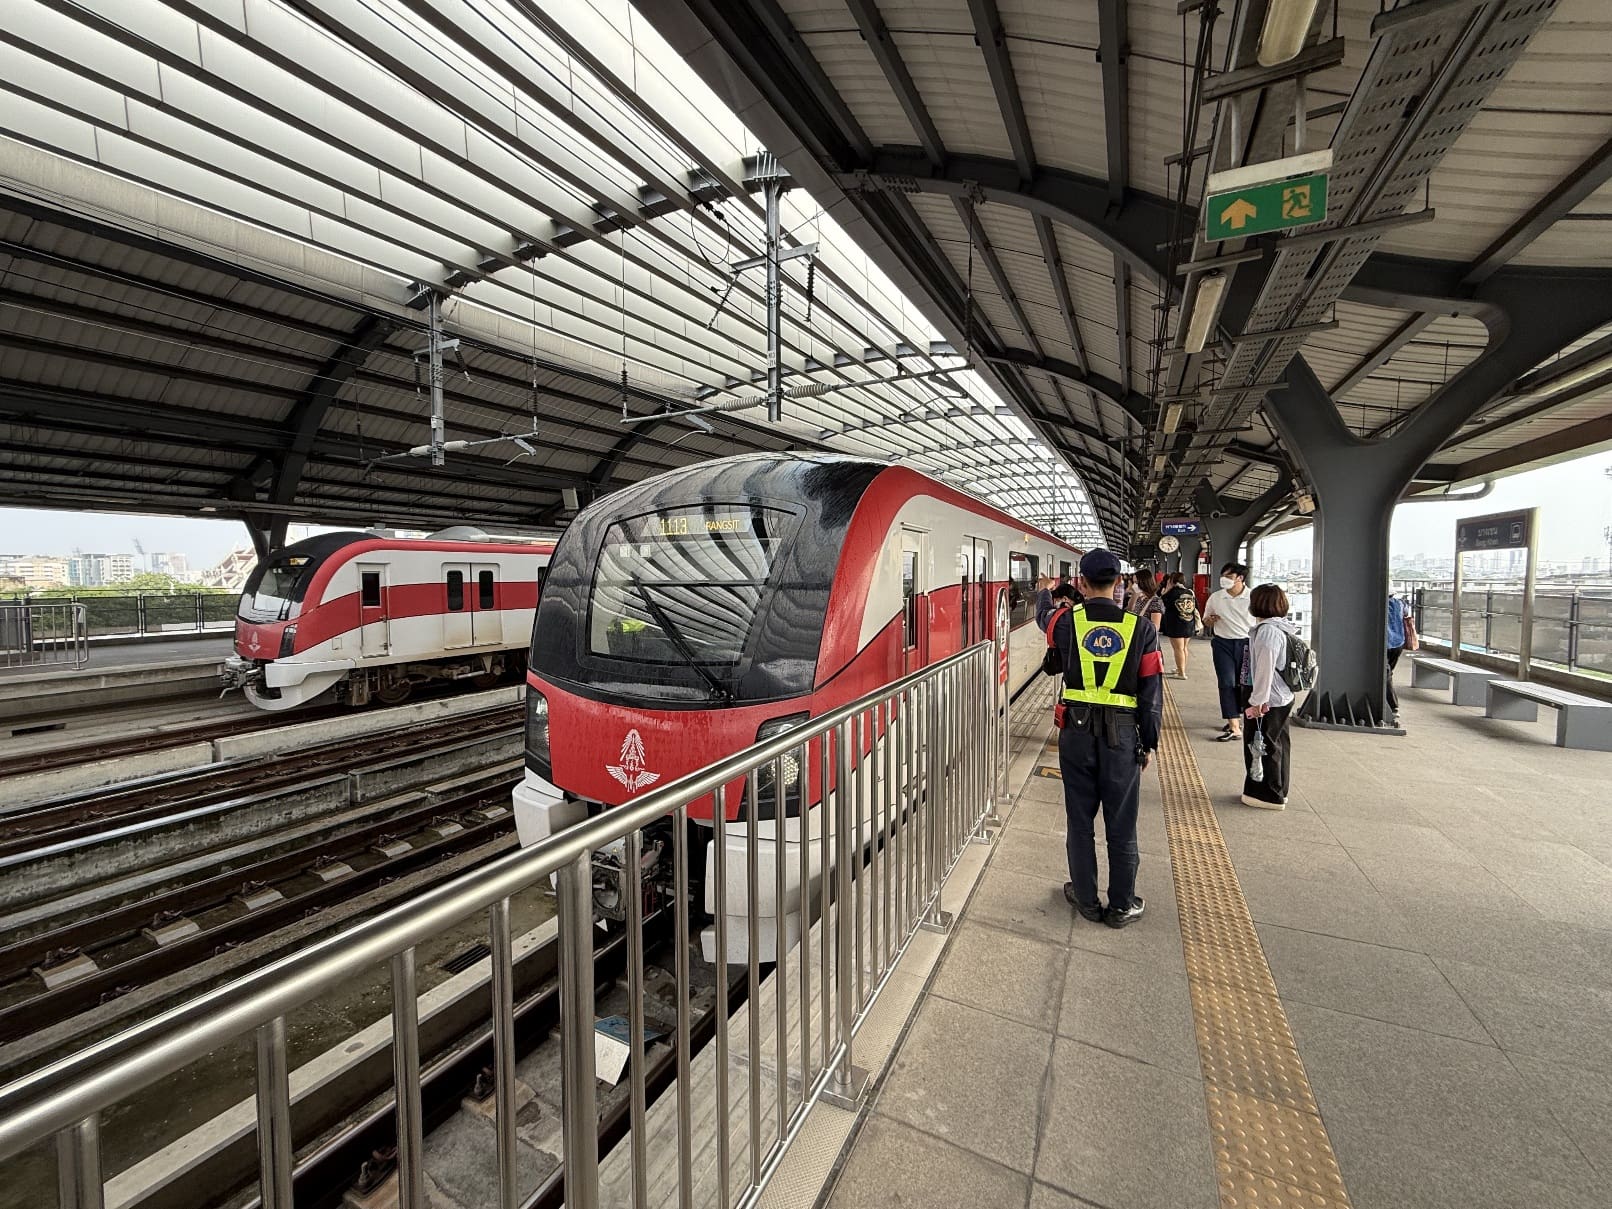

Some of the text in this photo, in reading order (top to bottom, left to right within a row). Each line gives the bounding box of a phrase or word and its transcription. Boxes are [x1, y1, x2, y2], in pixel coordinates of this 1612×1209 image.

[660, 517, 740, 535] 1113 RANGSIT
[1093, 635, 1112, 648] ACS
